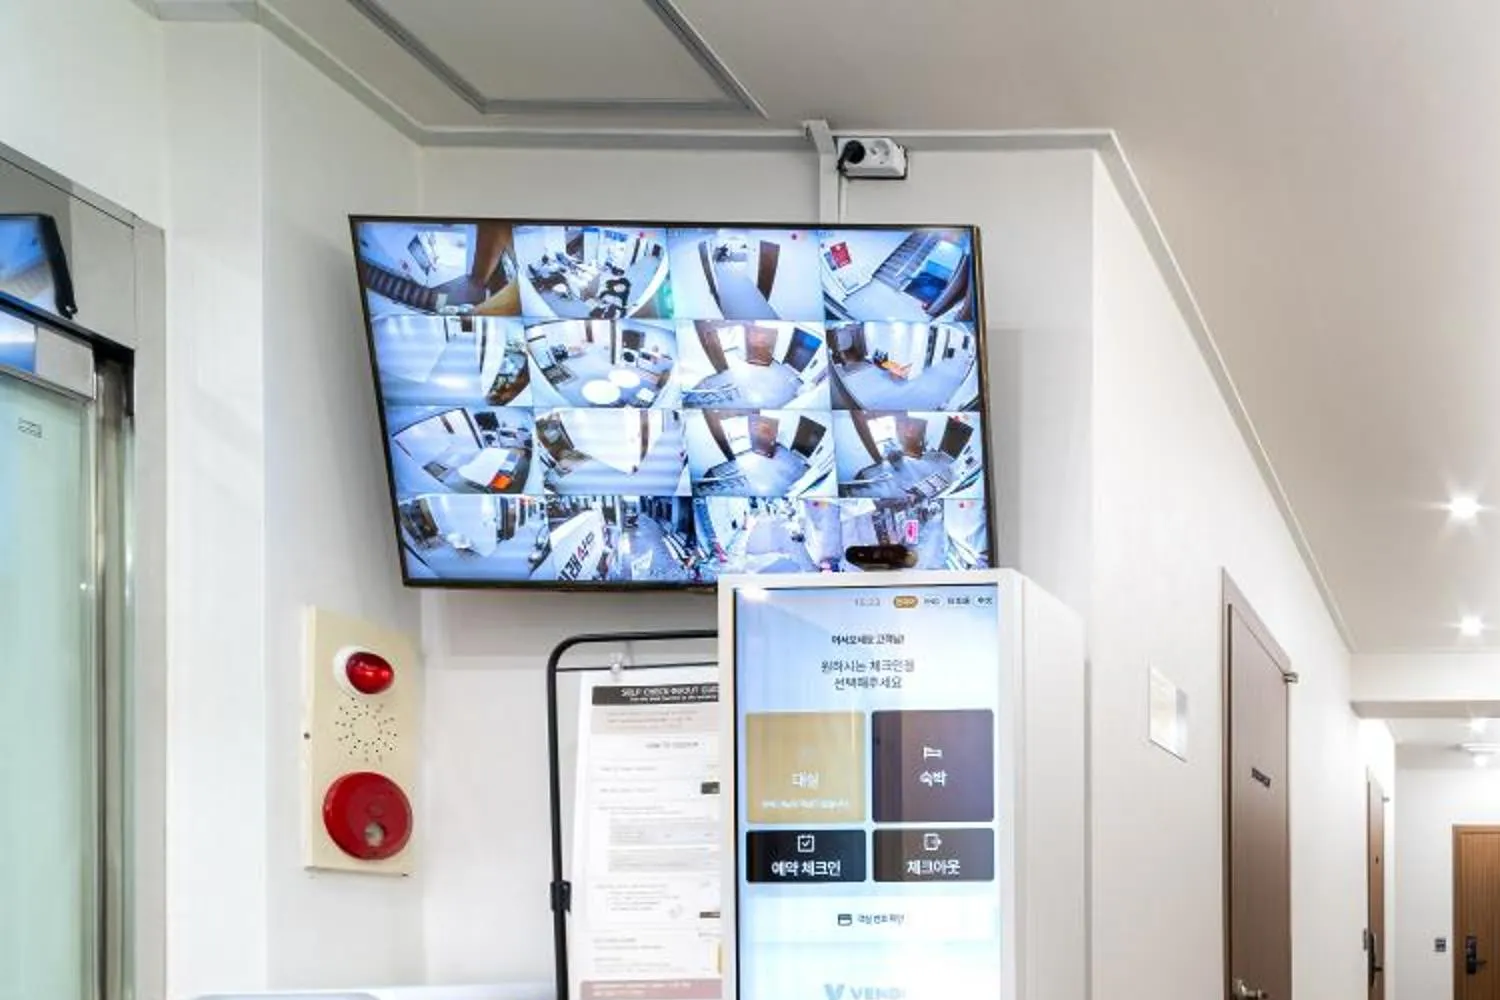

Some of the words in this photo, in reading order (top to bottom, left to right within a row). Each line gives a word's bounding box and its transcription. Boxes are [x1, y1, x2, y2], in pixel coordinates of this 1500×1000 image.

[821, 659, 867, 674] 원하시는
[834, 675, 902, 691] 선택해주세요
[771, 860, 799, 876] 예약
[802, 860, 841, 876] 체크인
[907, 860, 960, 875] 체크아웃
